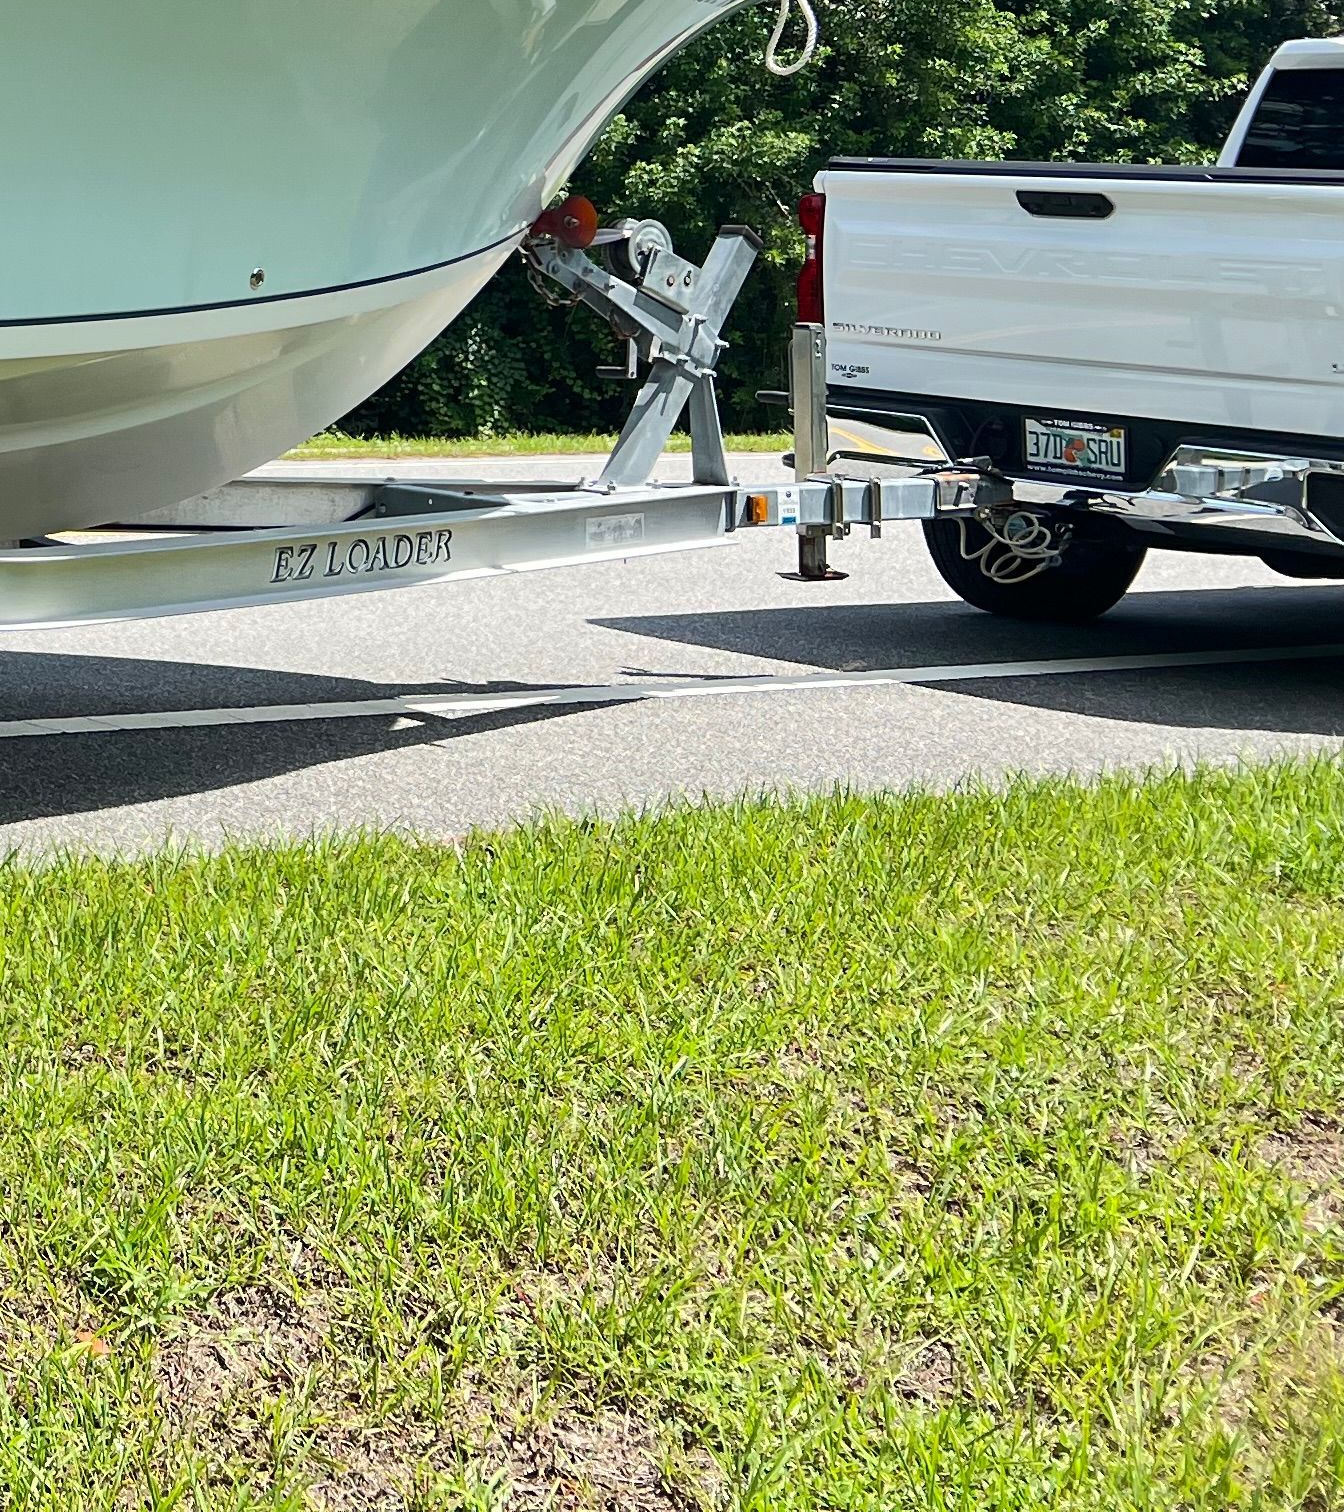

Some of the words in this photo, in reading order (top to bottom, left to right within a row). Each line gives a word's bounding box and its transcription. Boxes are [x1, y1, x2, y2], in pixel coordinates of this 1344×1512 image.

[831, 363, 847, 372] TOM
[1028, 430, 1063, 461] 37D
[1086, 437, 1121, 467] SRU
[269, 543, 318, 584] EZ
[322, 529, 453, 578] LOADER
